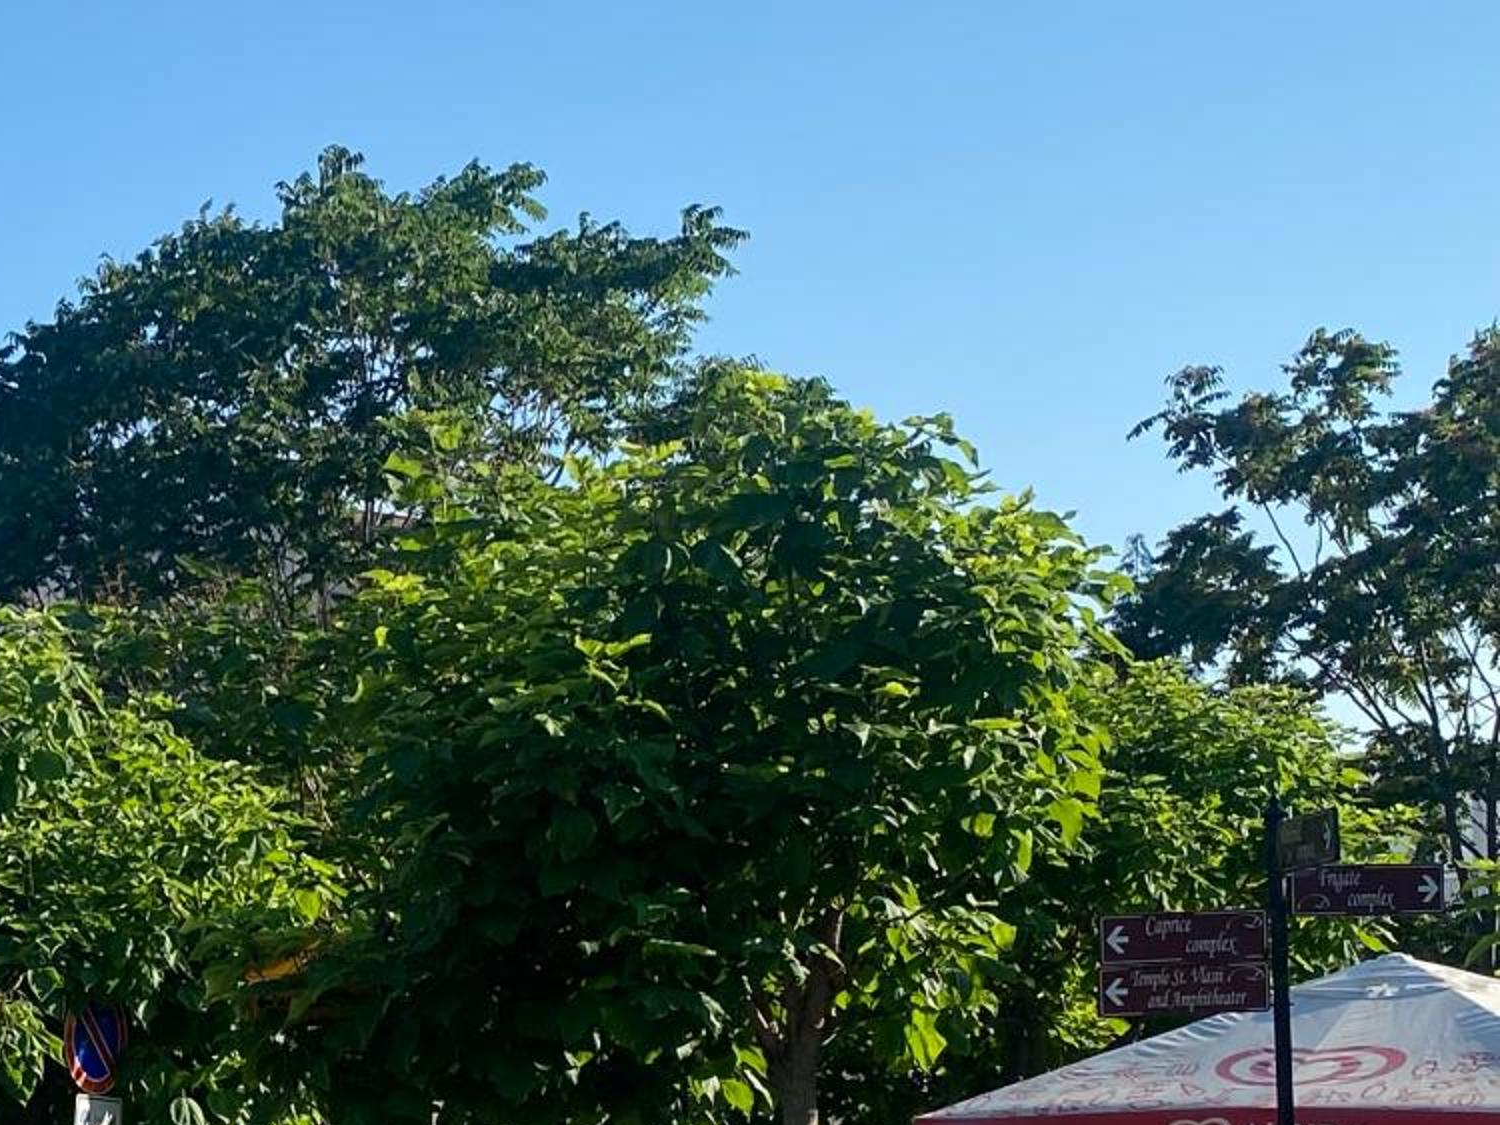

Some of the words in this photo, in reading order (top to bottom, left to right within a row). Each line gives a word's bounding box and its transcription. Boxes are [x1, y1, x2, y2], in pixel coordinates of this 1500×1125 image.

[1347, 884, 1396, 912] complex
[1145, 916, 1192, 941] Caprice
[1185, 931, 1238, 958] complex
[1131, 967, 1170, 992] Temple
[1148, 988, 1171, 1009] and
